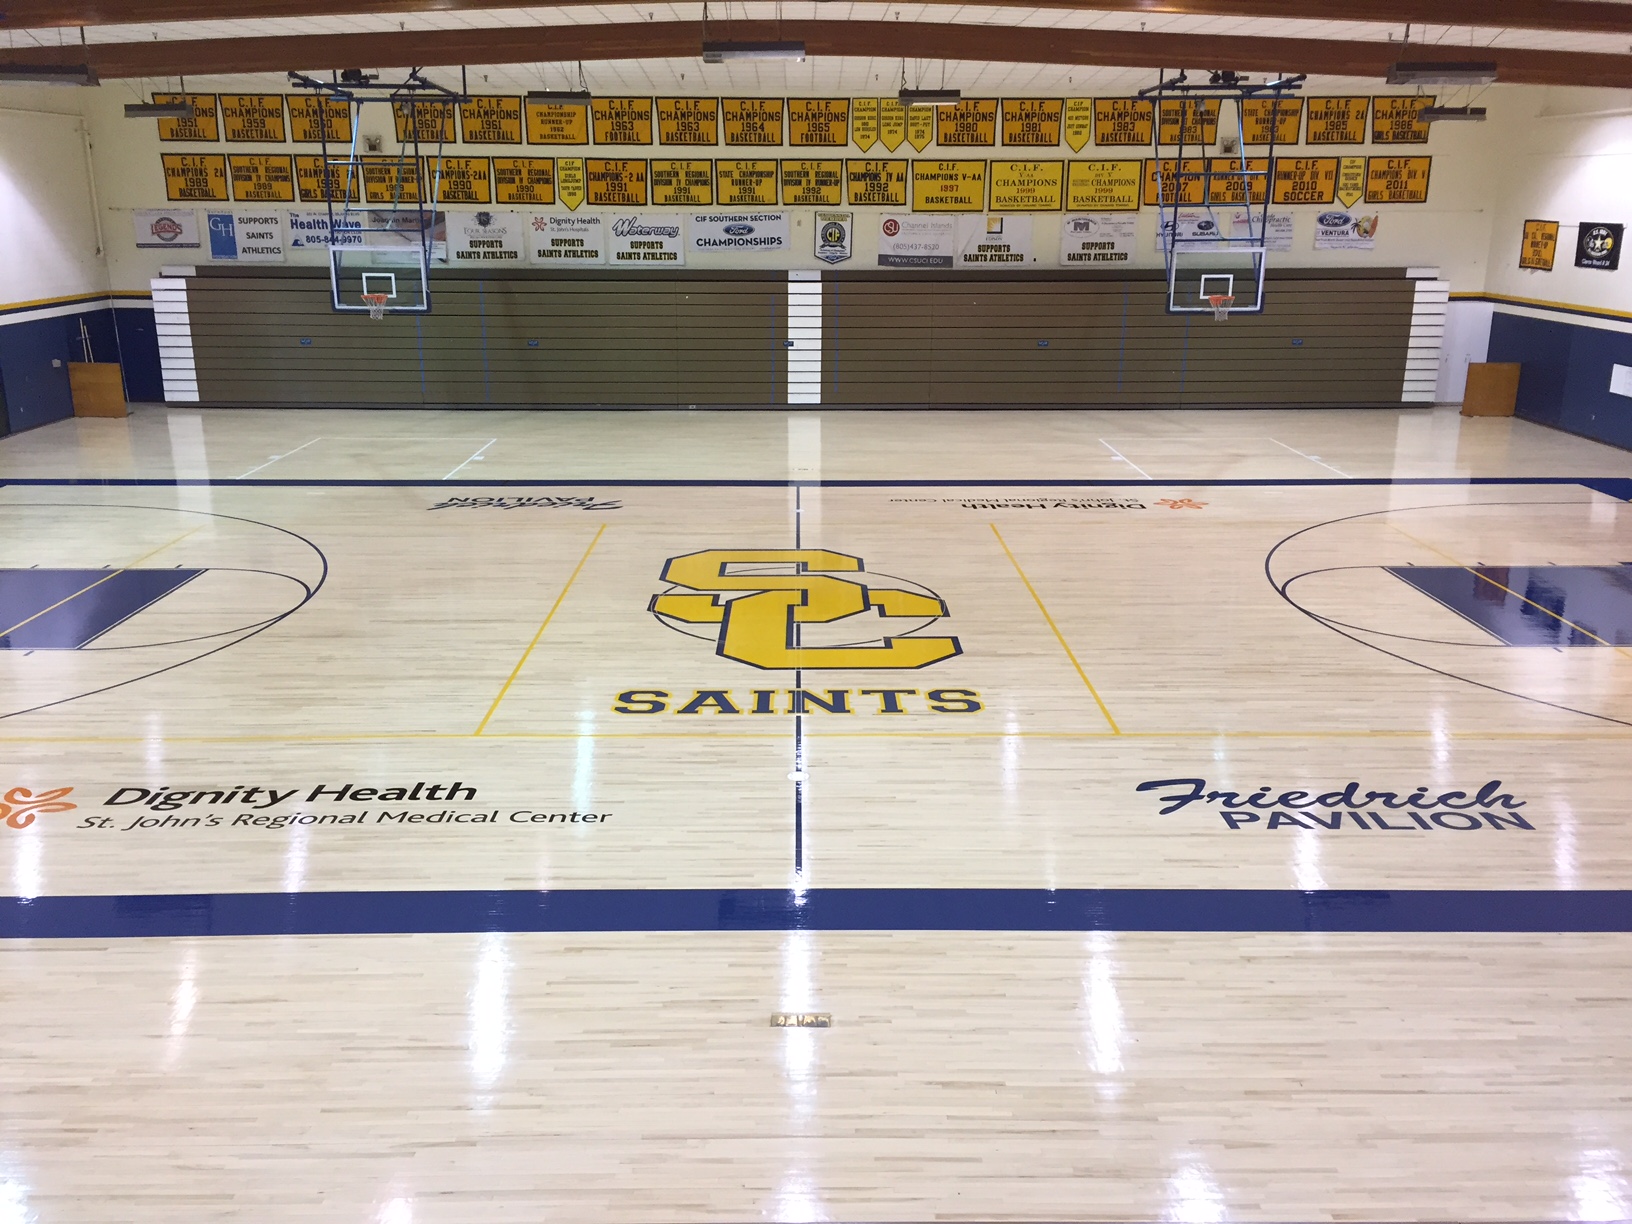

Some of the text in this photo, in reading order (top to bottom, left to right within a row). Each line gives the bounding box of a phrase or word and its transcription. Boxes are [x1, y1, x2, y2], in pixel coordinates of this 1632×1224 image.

[225, 108, 281, 118] CHAMPIONS
[462, 110, 519, 120] CHAMPIONS
[594, 110, 650, 121] CHAMPIONS
[660, 111, 715, 121] CHAMPIONS
[725, 111, 781, 122] CHAMPIONS
[791, 112, 846, 122] CHAMPIONS
[939, 112, 994, 122] CHAMPIONS
[1005, 112, 1059, 122] CHAMPIONS
[1097, 112, 1152, 122] CHAMPIONS
[1310, 110, 1350, 120] CHAMPIONS
[177, 118, 198, 127] 1951
[242, 119, 266, 128] 1959
[480, 120, 502, 130] 1961
[611, 121, 634, 131] 1963
[676, 122, 700, 131] 1963
[741, 122, 765, 132] 1964
[807, 122, 830, 132] 1965
[954, 123, 978, 132] 1980
[1021, 123, 1041, 132] 1981
[1112, 122, 1135, 131] 1983
[1325, 121, 1348, 130] 1985
[170, 128, 207, 138] BASEBALL
[232, 129, 278, 139] BASKETBALL
[469, 130, 514, 140] BASKETBALL
[605, 132, 641, 142] FOOTBALL
[666, 132, 710, 142] BASKETBALL
[730, 132, 775, 143] BASKETBALL
[800, 133, 836, 143] FOOTBALL
[944, 133, 988, 143] BASKETBALL
[1009, 133, 1052, 143] BASKETBALL
[1101, 133, 1144, 142] BASKETBALL
[1313, 131, 1357, 141] BASKETBALL
[1392, 131, 1428, 140] BASKETBALL
[166, 168, 208, 177] CHAMPIONS
[589, 172, 623, 182] CHAMPIONS
[850, 172, 882, 182] CHAMPIONS
[1370, 170, 1402, 179] CHAMPIONS
[185, 178, 208, 187] 1989
[448, 181, 472, 190] 1990
[606, 182, 627, 192] 1991
[865, 182, 888, 192] 1992
[1292, 181, 1317, 190] 2010
[1386, 180, 1408, 190] 2011
[179, 188, 216, 198] BASKETBALL
[443, 190, 479, 200] BASKETBALL
[594, 192, 639, 202] BASKETBALL
[854, 192, 899, 202] BASKETBALL
[1283, 191, 1324, 201] SOCCER
[1368, 191, 1422, 200] GIRLS BASKETBALL
[550, 217, 576, 226] Dignity
[1323, 213, 1345, 225] Ford
[290, 219, 328, 230] Health
[612, 216, 679, 238] Waterway
[729, 226, 748, 234] Ford
[469, 240, 503, 248] SUPPORTS
[551, 238, 584, 247] SUPPORTS
[630, 241, 663, 249] SUPPORTS
[696, 236, 782, 246] CHAMPIONSHIPS
[1081, 242, 1115, 250] SUPPORTS
[537, 249, 599, 258] SAINTS ATHLETICS
[978, 244, 1011, 253] SUPPORTS
[456, 251, 518, 259] SAINTS ATHLETICS
[616, 252, 678, 260] SAINTS ATHLETICS
[963, 254, 1024, 262] SAINTS ATHLETICS
[1067, 253, 1128, 261] SAINTS ATHLETICS
[610, 689, 985, 715] SAINTS
[103, 781, 478, 811] Dignity Health
[1135, 777, 1527, 816] Friedrich
[76, 810, 613, 831] St. John's Regional Medical Center
[1219, 811, 1537, 831] PAVILION
